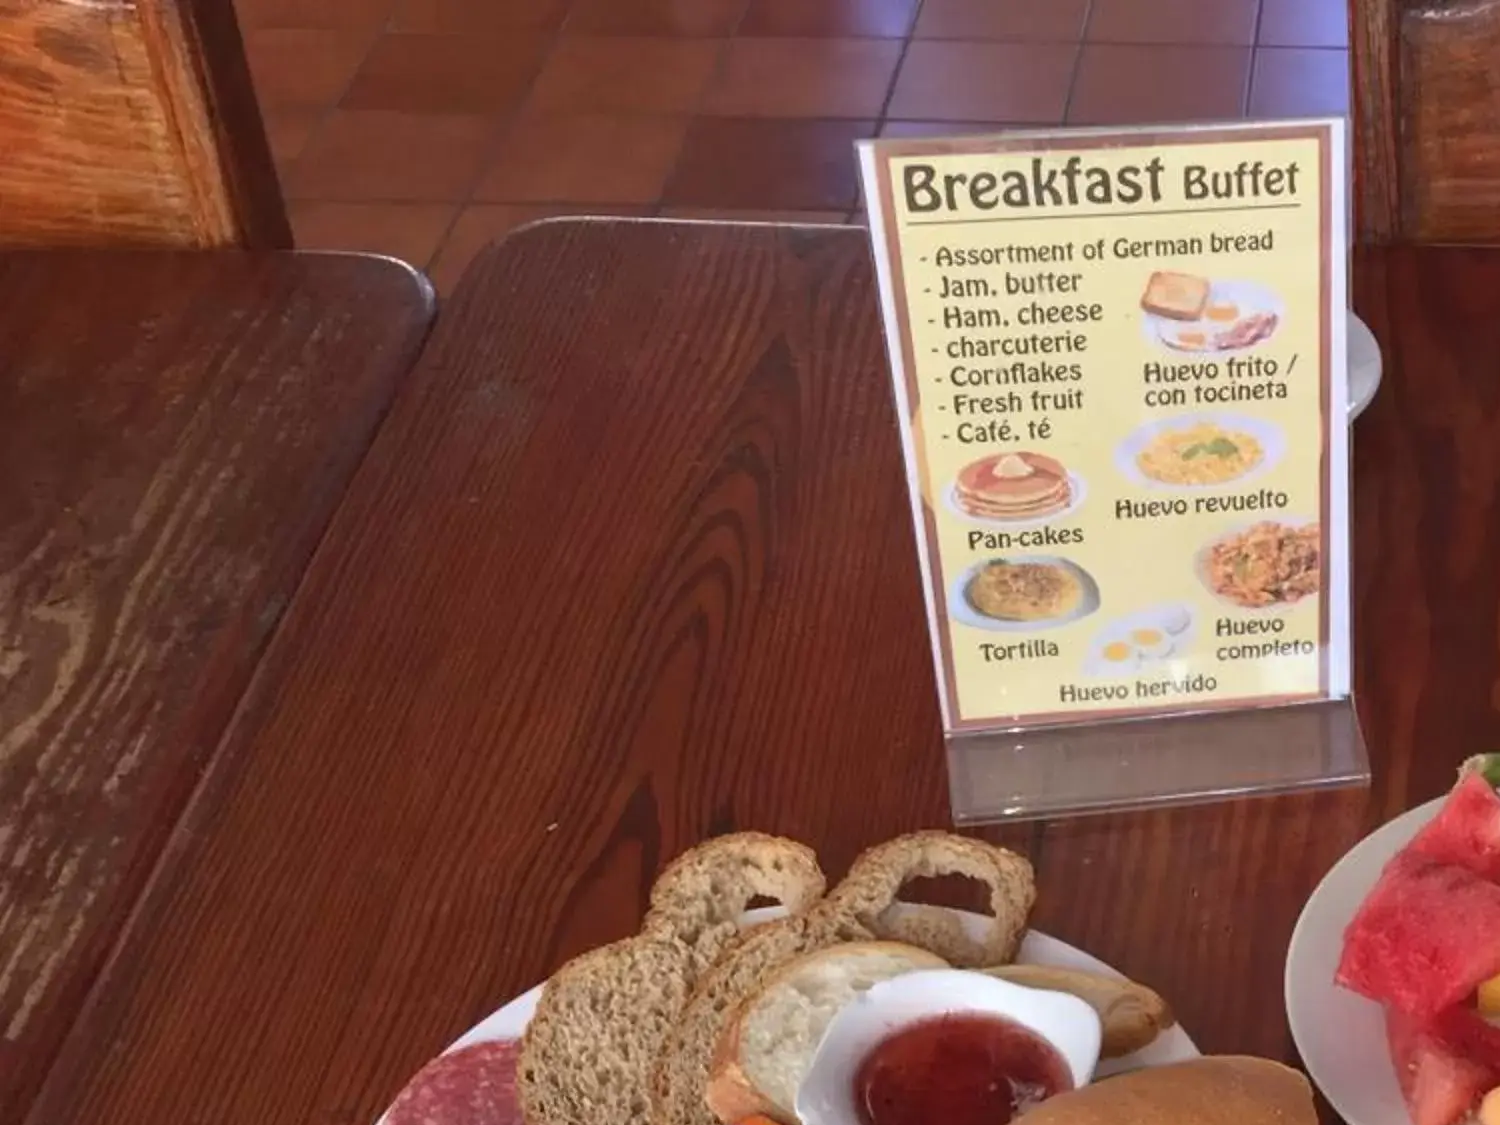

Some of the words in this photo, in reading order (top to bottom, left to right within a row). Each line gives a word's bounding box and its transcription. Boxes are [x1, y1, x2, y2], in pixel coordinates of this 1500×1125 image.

[903, 157, 1165, 213] Breakfast
[1184, 161, 1300, 200] Buffet
[936, 242, 1074, 267] Assortment
[1082, 239, 1104, 260] of
[1113, 238, 1202, 259] German
[1210, 229, 1273, 253] bread
[1005, 272, 1083, 295] butter
[1017, 301, 1103, 325] cheese
[947, 330, 1087, 358] charcuterie
[950, 361, 1082, 387] Cornflakes
[1144, 362, 1219, 384] Huevo
[1226, 356, 1278, 379] frito
[953, 391, 1022, 415] Fresh
[1030, 388, 1084, 411] fruit
[1144, 388, 1186, 407] con
[1194, 380, 1288, 403] tocineta
[1027, 417, 1051, 440] té
[1115, 499, 1188, 520] Huevo
[1195, 489, 1288, 513] revuelto
[968, 525, 1084, 551] Pan-cakes
[1216, 618, 1284, 637] Huevo
[979, 640, 1059, 662] Tortilla
[1216, 638, 1314, 663] completo
[1060, 684, 1129, 702] Huevo
[1136, 674, 1217, 698] hervido
